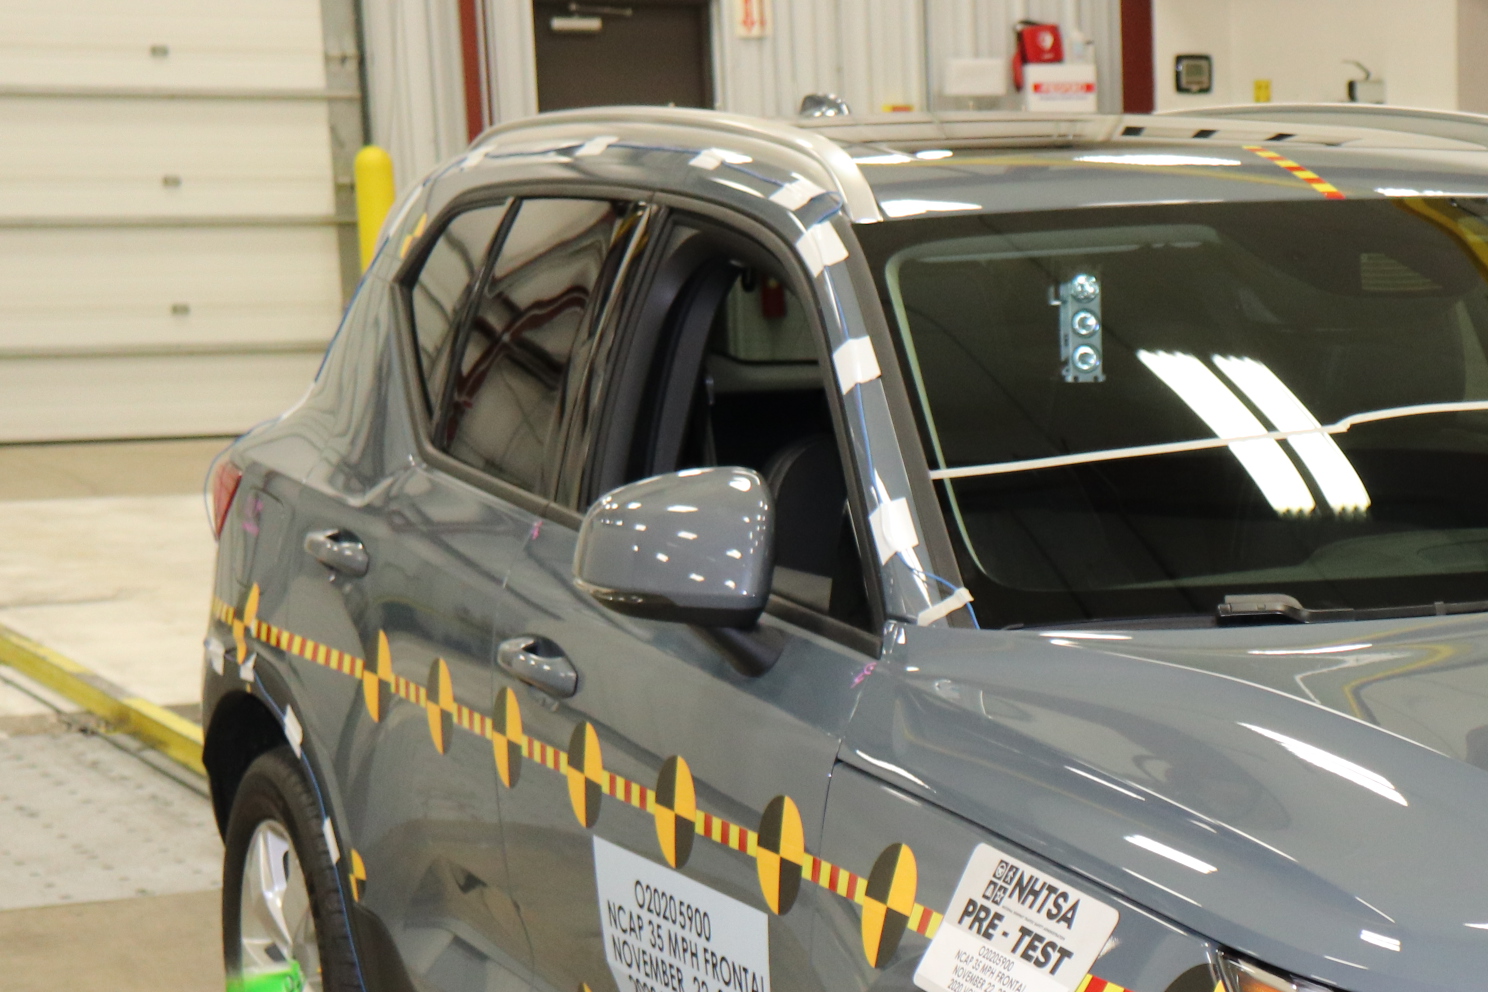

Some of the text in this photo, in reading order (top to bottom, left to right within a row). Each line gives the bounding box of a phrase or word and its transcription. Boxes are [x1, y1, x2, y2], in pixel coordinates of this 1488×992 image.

[1008, 871, 1080, 930] NHTSA
[607, 899, 644, 942] NCAP
[648, 919, 665, 952] 35
[668, 929, 700, 971] MPH
[955, 949, 974, 966] NCAP
[972, 958, 982, 971] 35
[980, 963, 997, 979] MPH
[957, 898, 1005, 941] PRE
[1010, 925, 1074, 976] TEST
[952, 964, 986, 990] NOVEMBER
